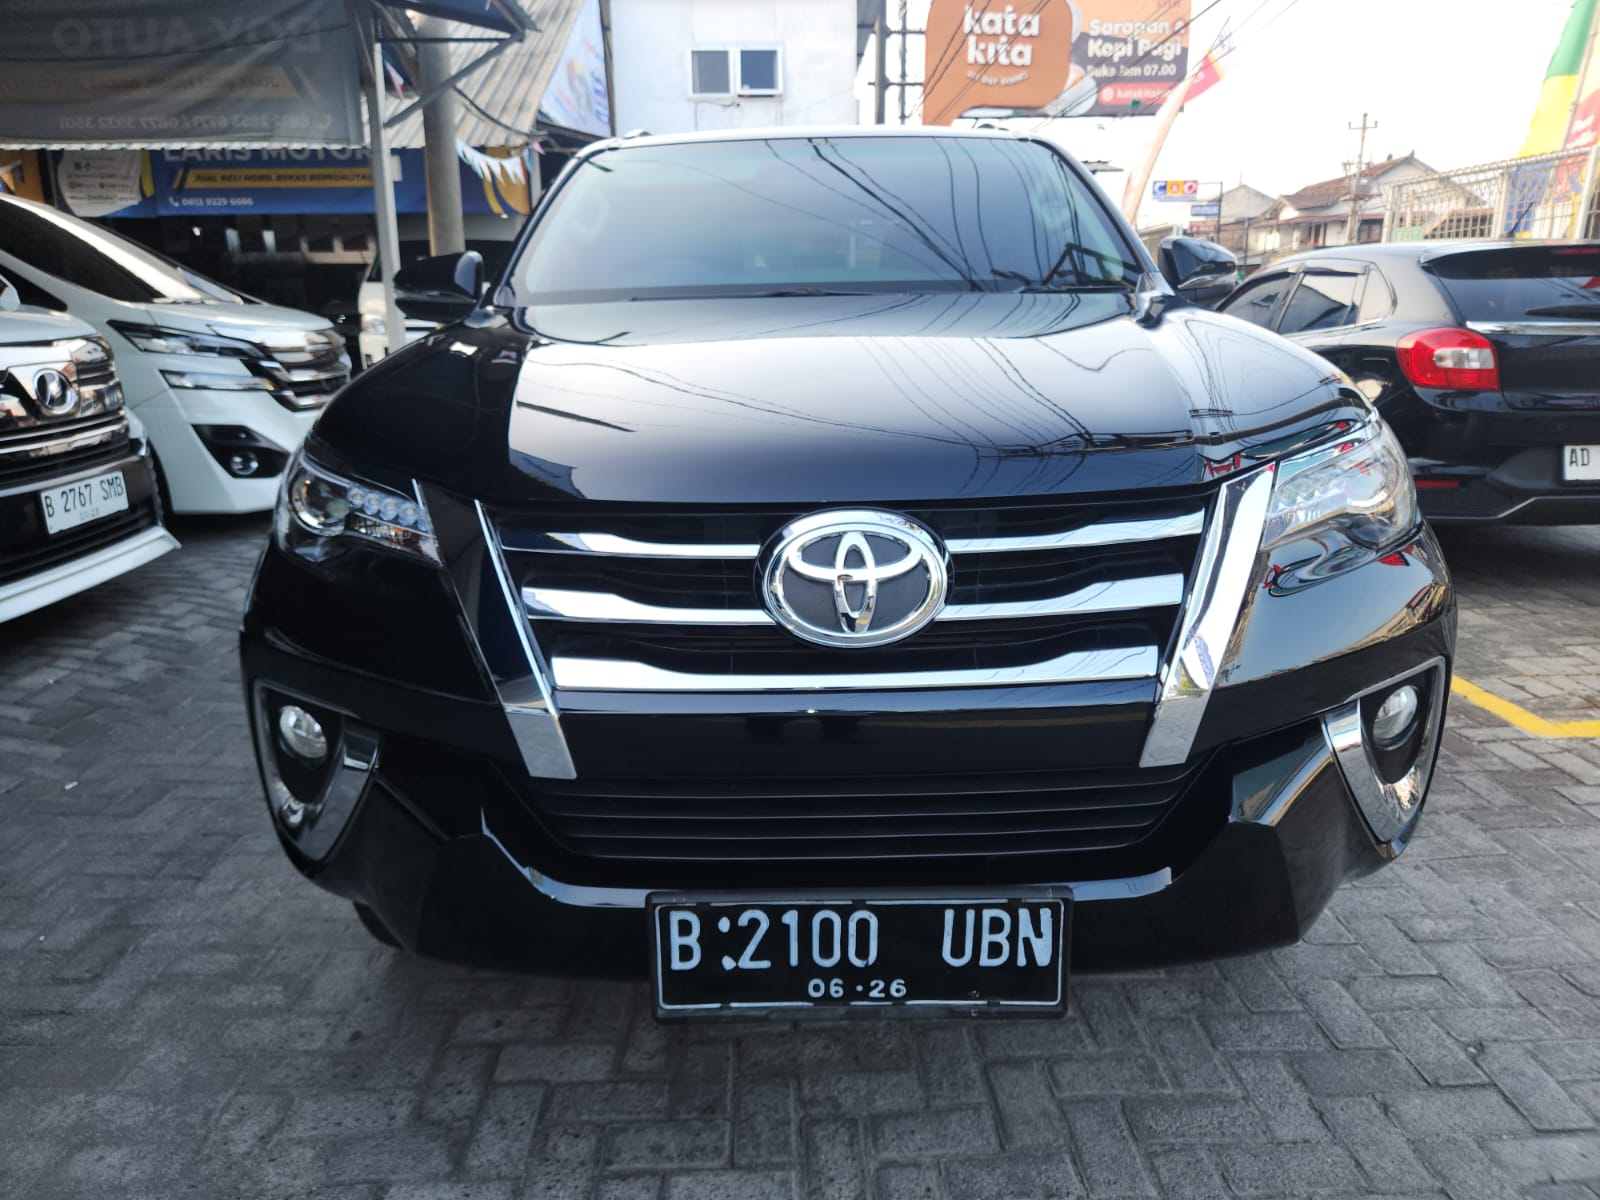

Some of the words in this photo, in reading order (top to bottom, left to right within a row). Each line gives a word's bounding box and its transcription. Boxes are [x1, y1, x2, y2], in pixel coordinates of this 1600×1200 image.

[964, 5, 1040, 36] kata
[1088, 18, 1169, 40] Sarapan
[967, 35, 1032, 66] kita
[1087, 38, 1132, 62] Kopi
[1139, 36, 1182, 61] Pagi
[1143, 64, 1176, 76] 07.00
[1569, 448, 1590, 467] AD
[44, 495, 55, 519] B
[61, 484, 93, 513] 2767
[100, 476, 124, 501] SMB
[669, 909, 702, 971] B
[737, 909, 879, 969] 2100
[942, 907, 1053, 968] UBN
